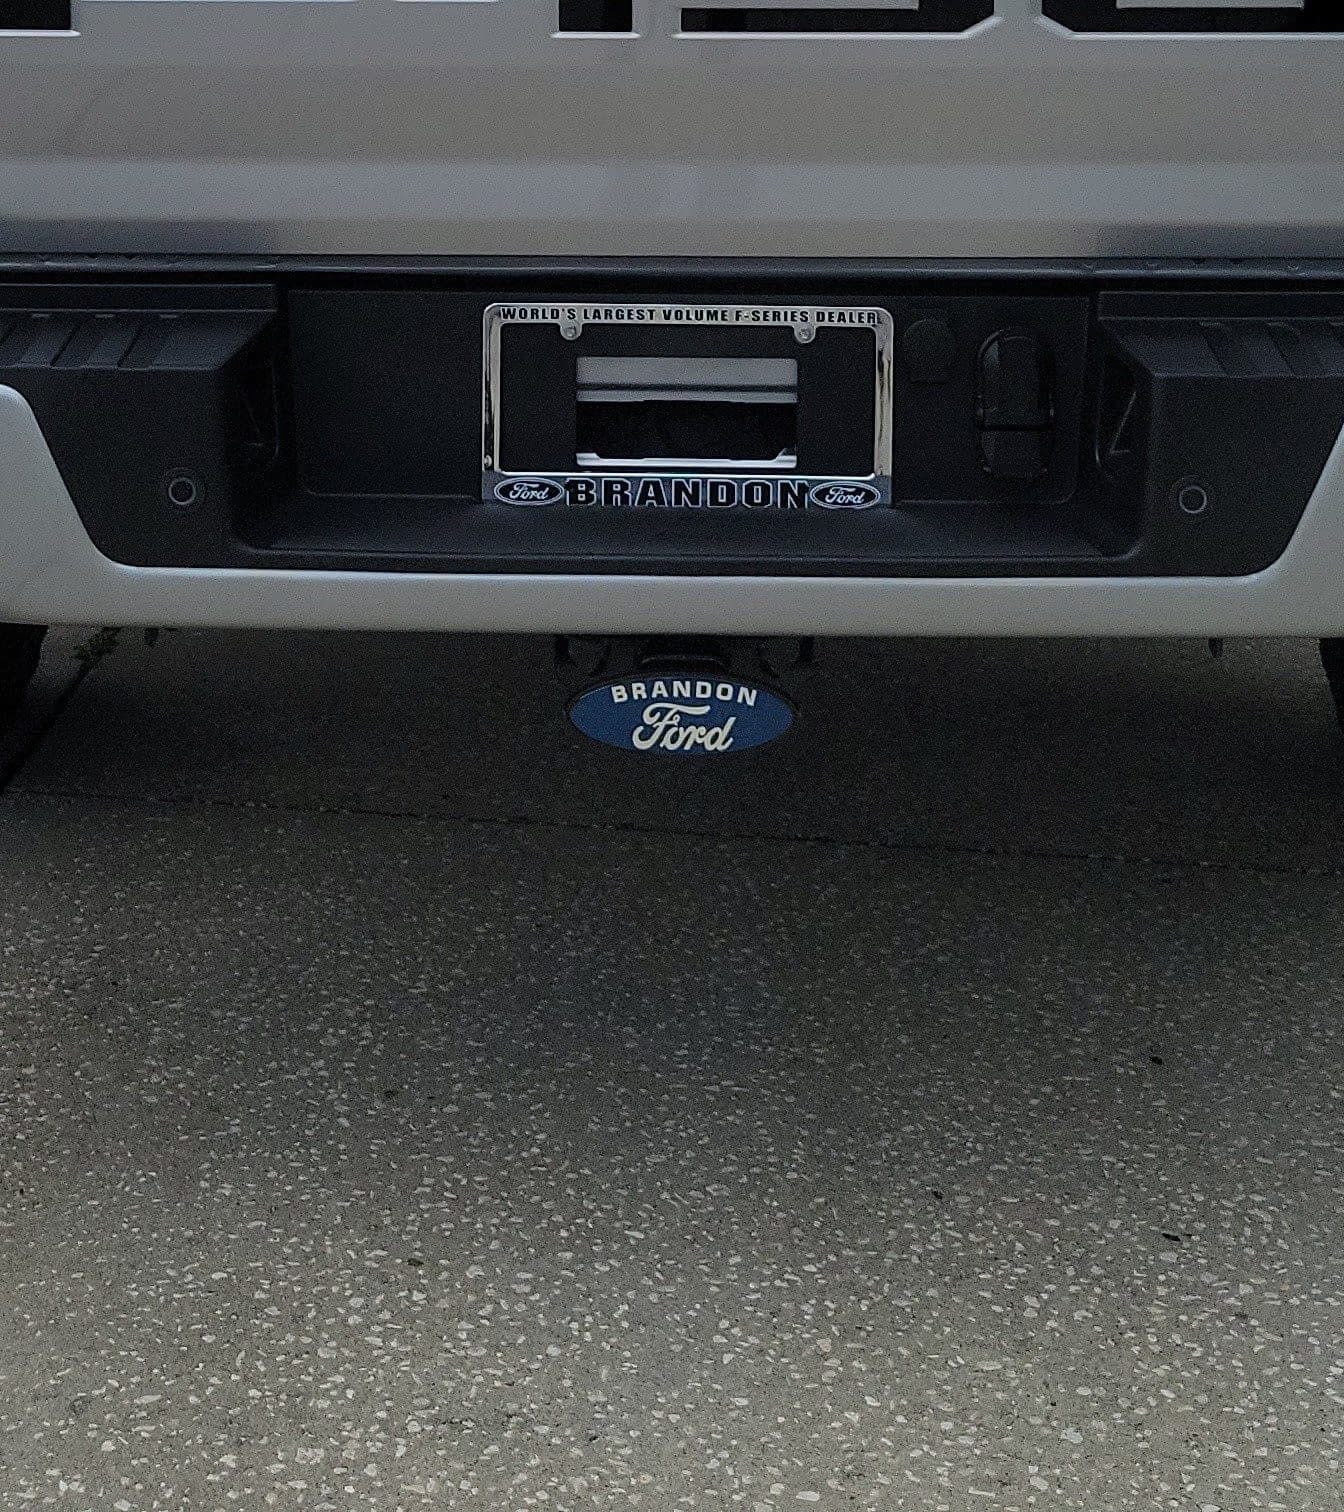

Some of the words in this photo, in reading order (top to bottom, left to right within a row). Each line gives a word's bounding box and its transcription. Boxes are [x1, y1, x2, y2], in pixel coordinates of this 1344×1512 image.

[501, 306, 576, 320] WORLD'S
[582, 307, 656, 322] LARGEST
[662, 308, 728, 322] VOLUME
[734, 309, 810, 324] F-SERIES
[815, 310, 880, 325] DEALER
[509, 481, 550, 502] Ford
[564, 478, 809, 509] BRANDON
[825, 485, 866, 506] Ford
[610, 680, 758, 707] BRANDON
[632, 702, 737, 751] Ford
